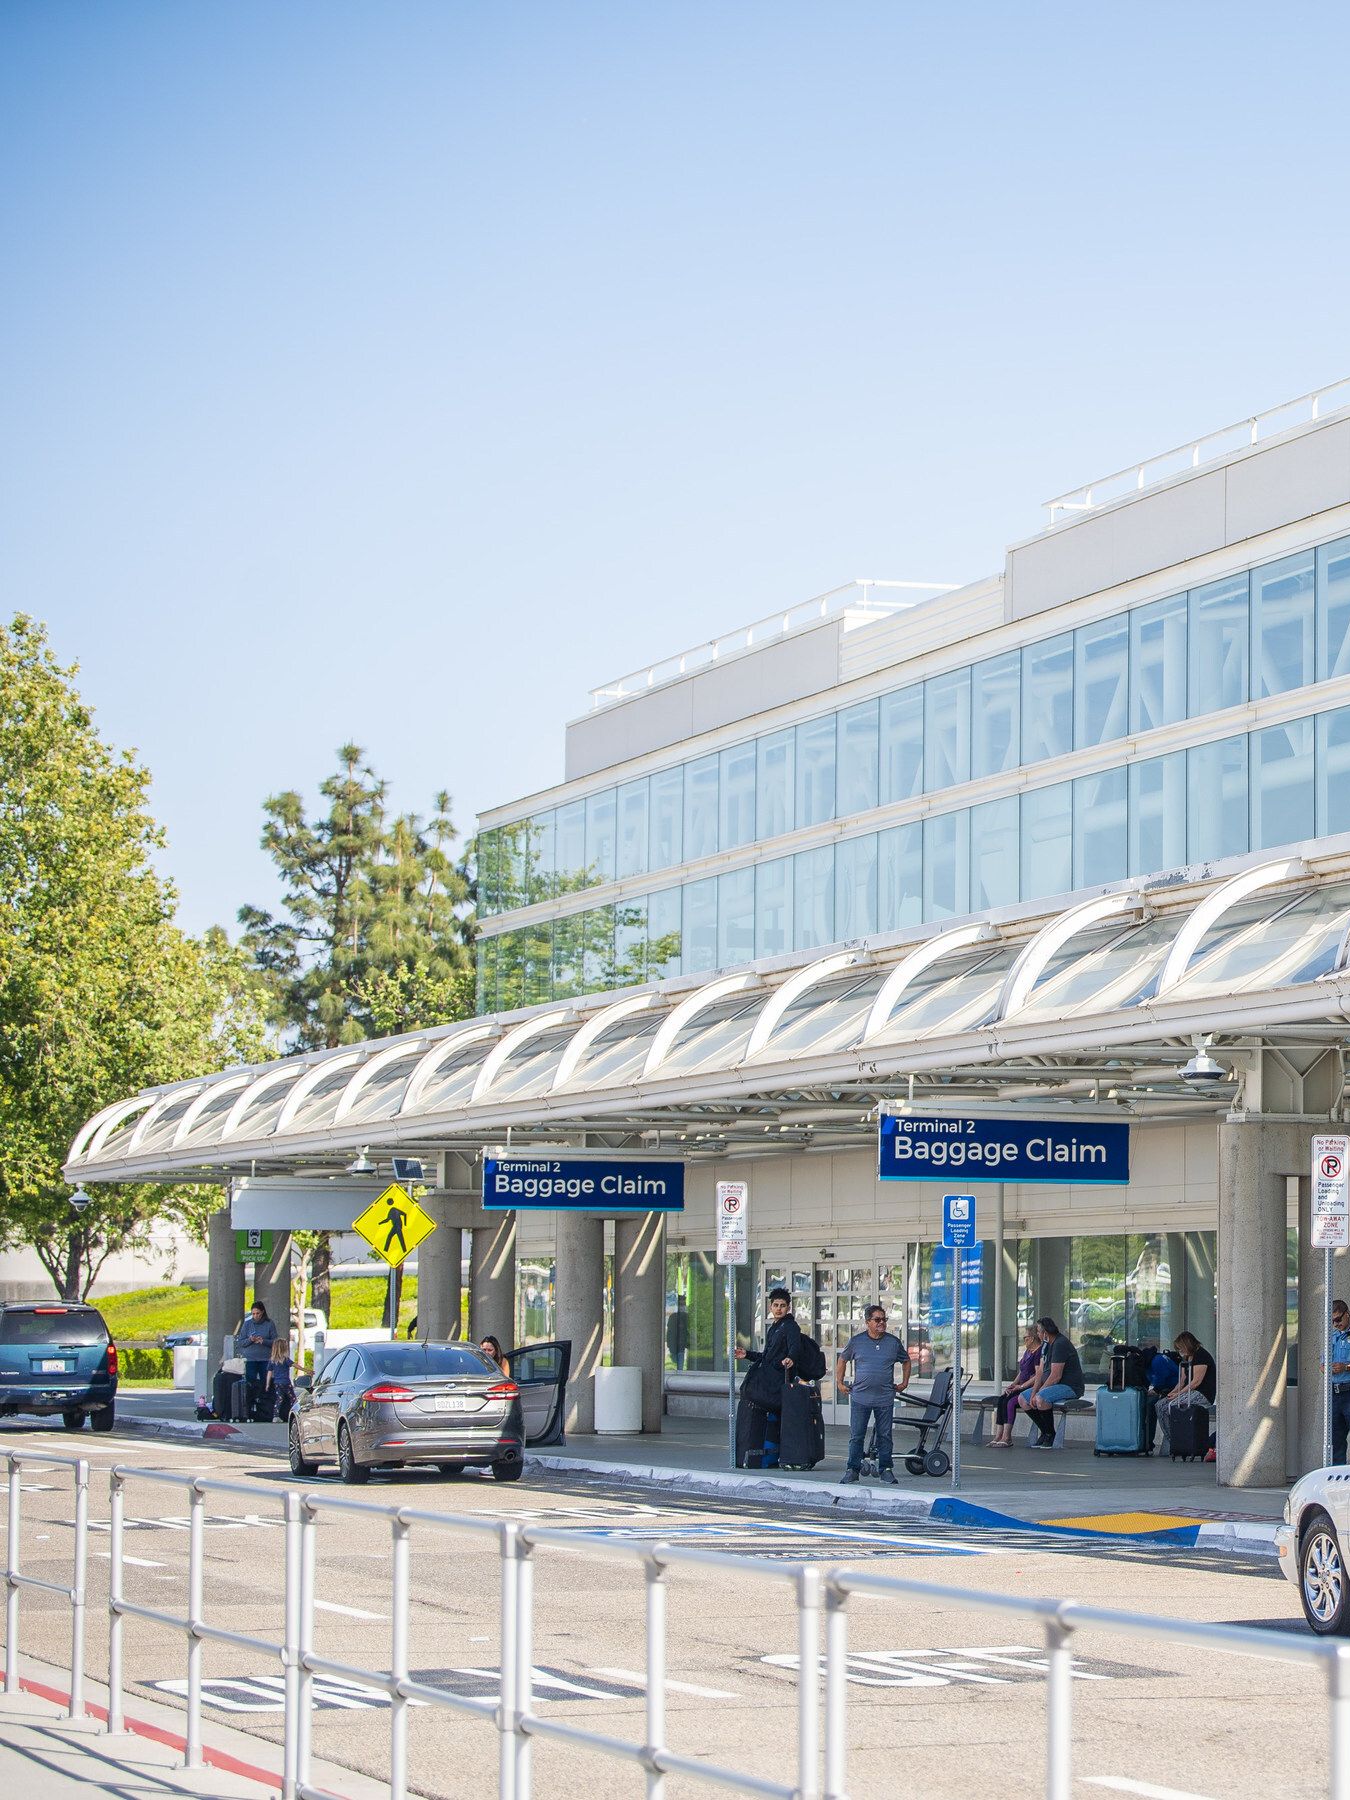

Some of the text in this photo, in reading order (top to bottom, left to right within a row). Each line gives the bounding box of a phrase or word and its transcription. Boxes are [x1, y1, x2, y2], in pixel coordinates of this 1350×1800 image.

[895, 1119, 976, 1134] Terminal 2
[894, 1136, 1106, 1167] Baggage Claim
[496, 1161, 561, 1173] Terminal 2
[495, 1174, 666, 1198] Baggage Claim
